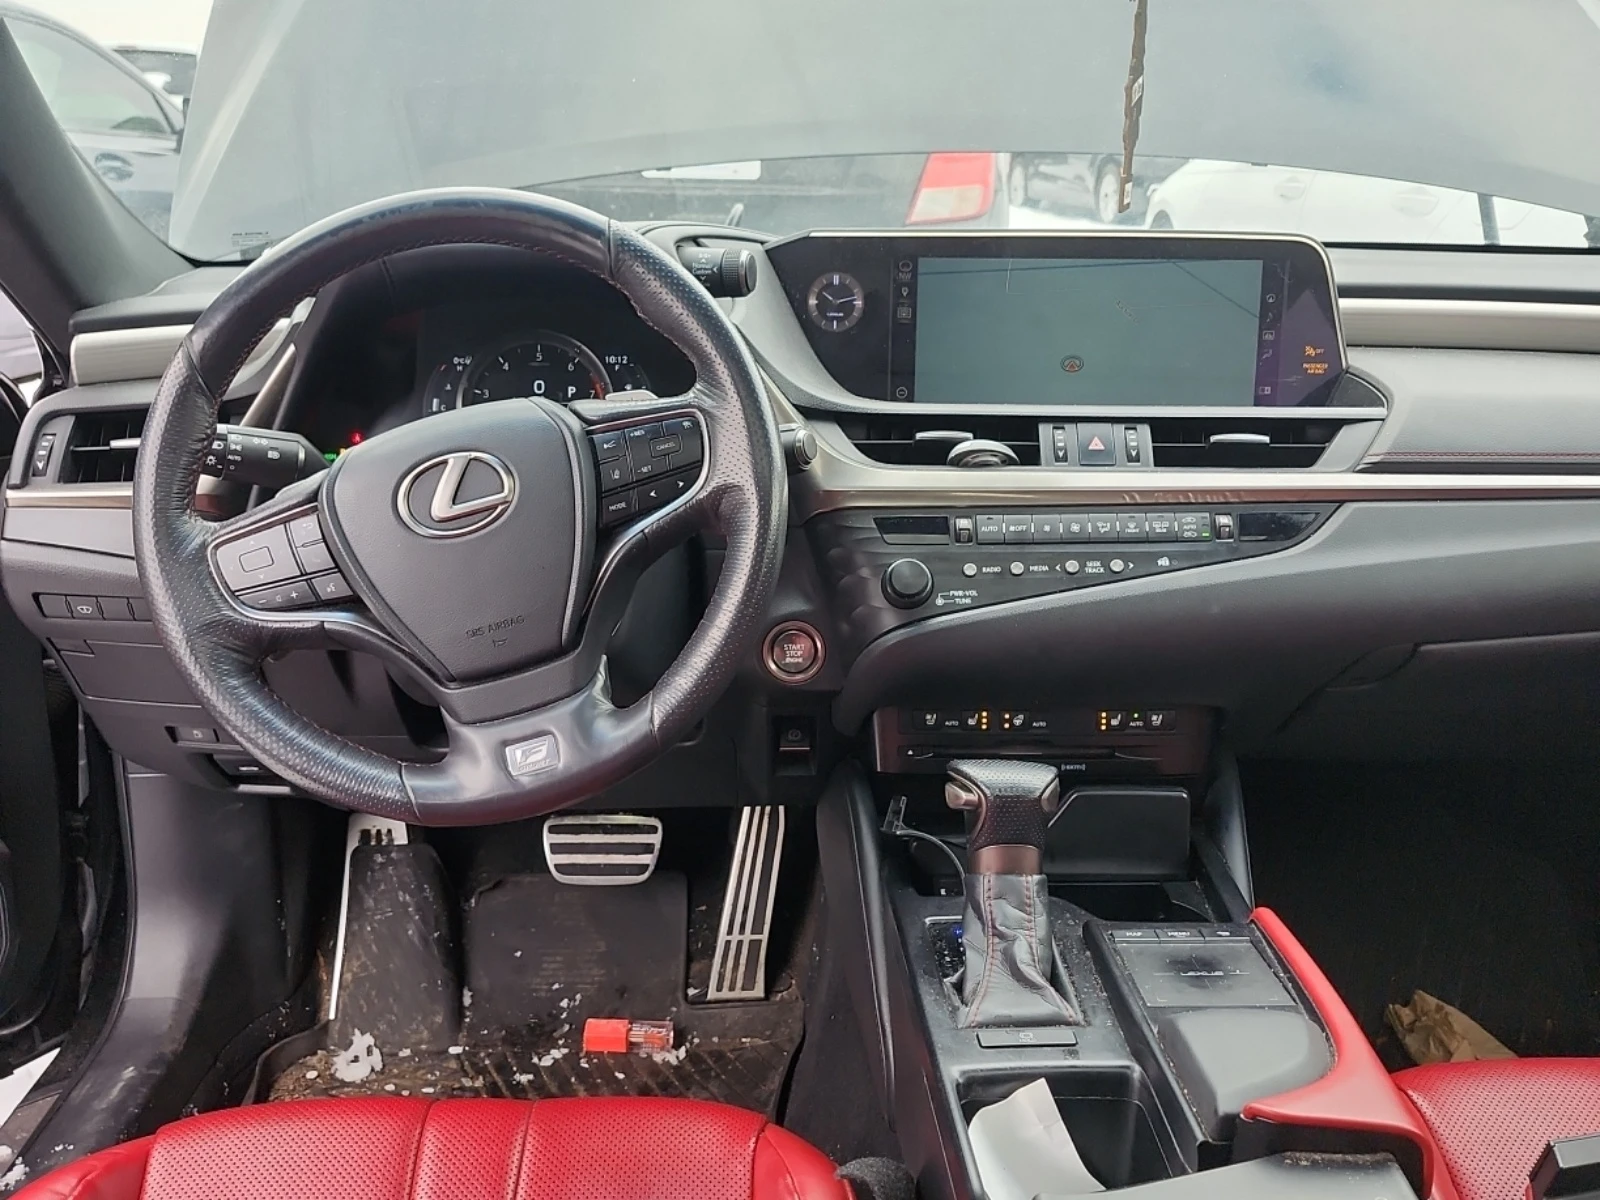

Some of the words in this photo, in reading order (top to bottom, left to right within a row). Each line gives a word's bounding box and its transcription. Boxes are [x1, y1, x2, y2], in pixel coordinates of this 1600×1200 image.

[536, 353, 543, 361] 5
[605, 356, 628, 364] 10:12
[502, 362, 509, 371] 4
[567, 363, 575, 371] 6
[482, 389, 490, 398] 3
[567, 386, 577, 398] P
[589, 390, 596, 399] 7
[608, 502, 627, 512] MODE
[487, 615, 525, 634] AIRBAG
[783, 643, 805, 651] START
